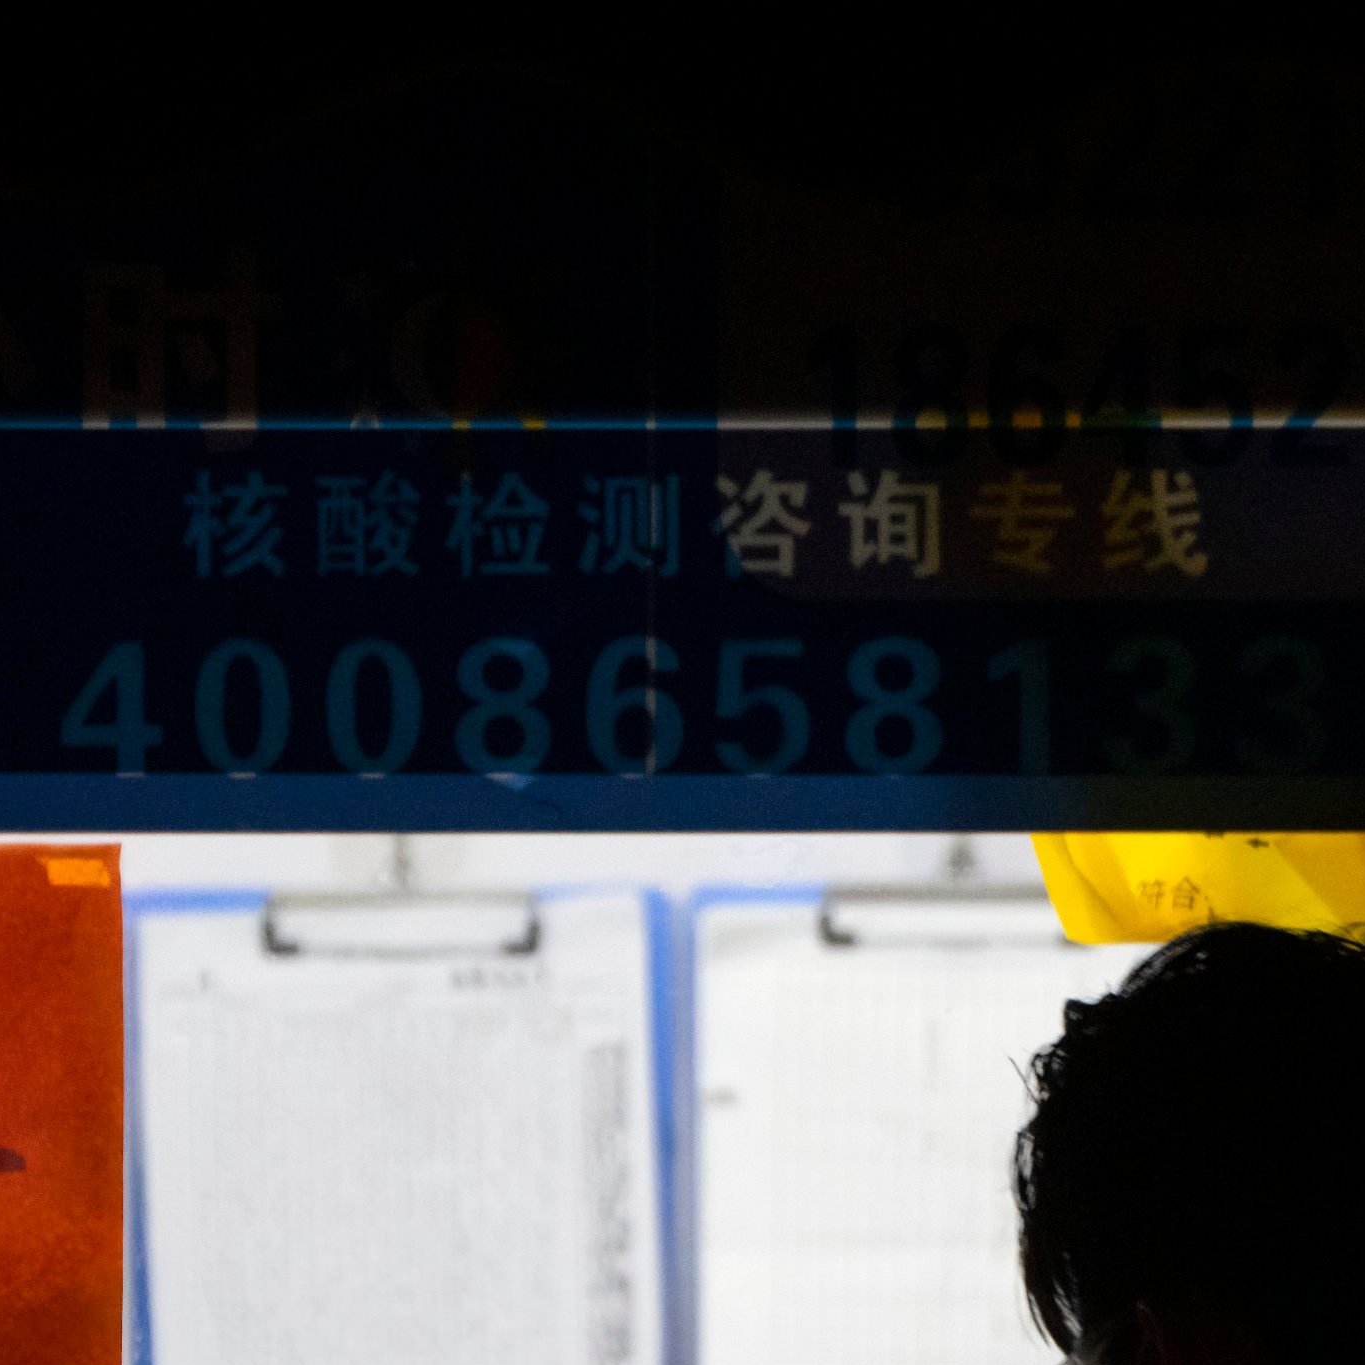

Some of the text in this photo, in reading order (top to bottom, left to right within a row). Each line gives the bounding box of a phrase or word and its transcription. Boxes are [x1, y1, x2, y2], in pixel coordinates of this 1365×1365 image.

[180, 467, 1210, 579] 核酸检测咨询专线
[59, 635, 1332, 780] 4008658133
